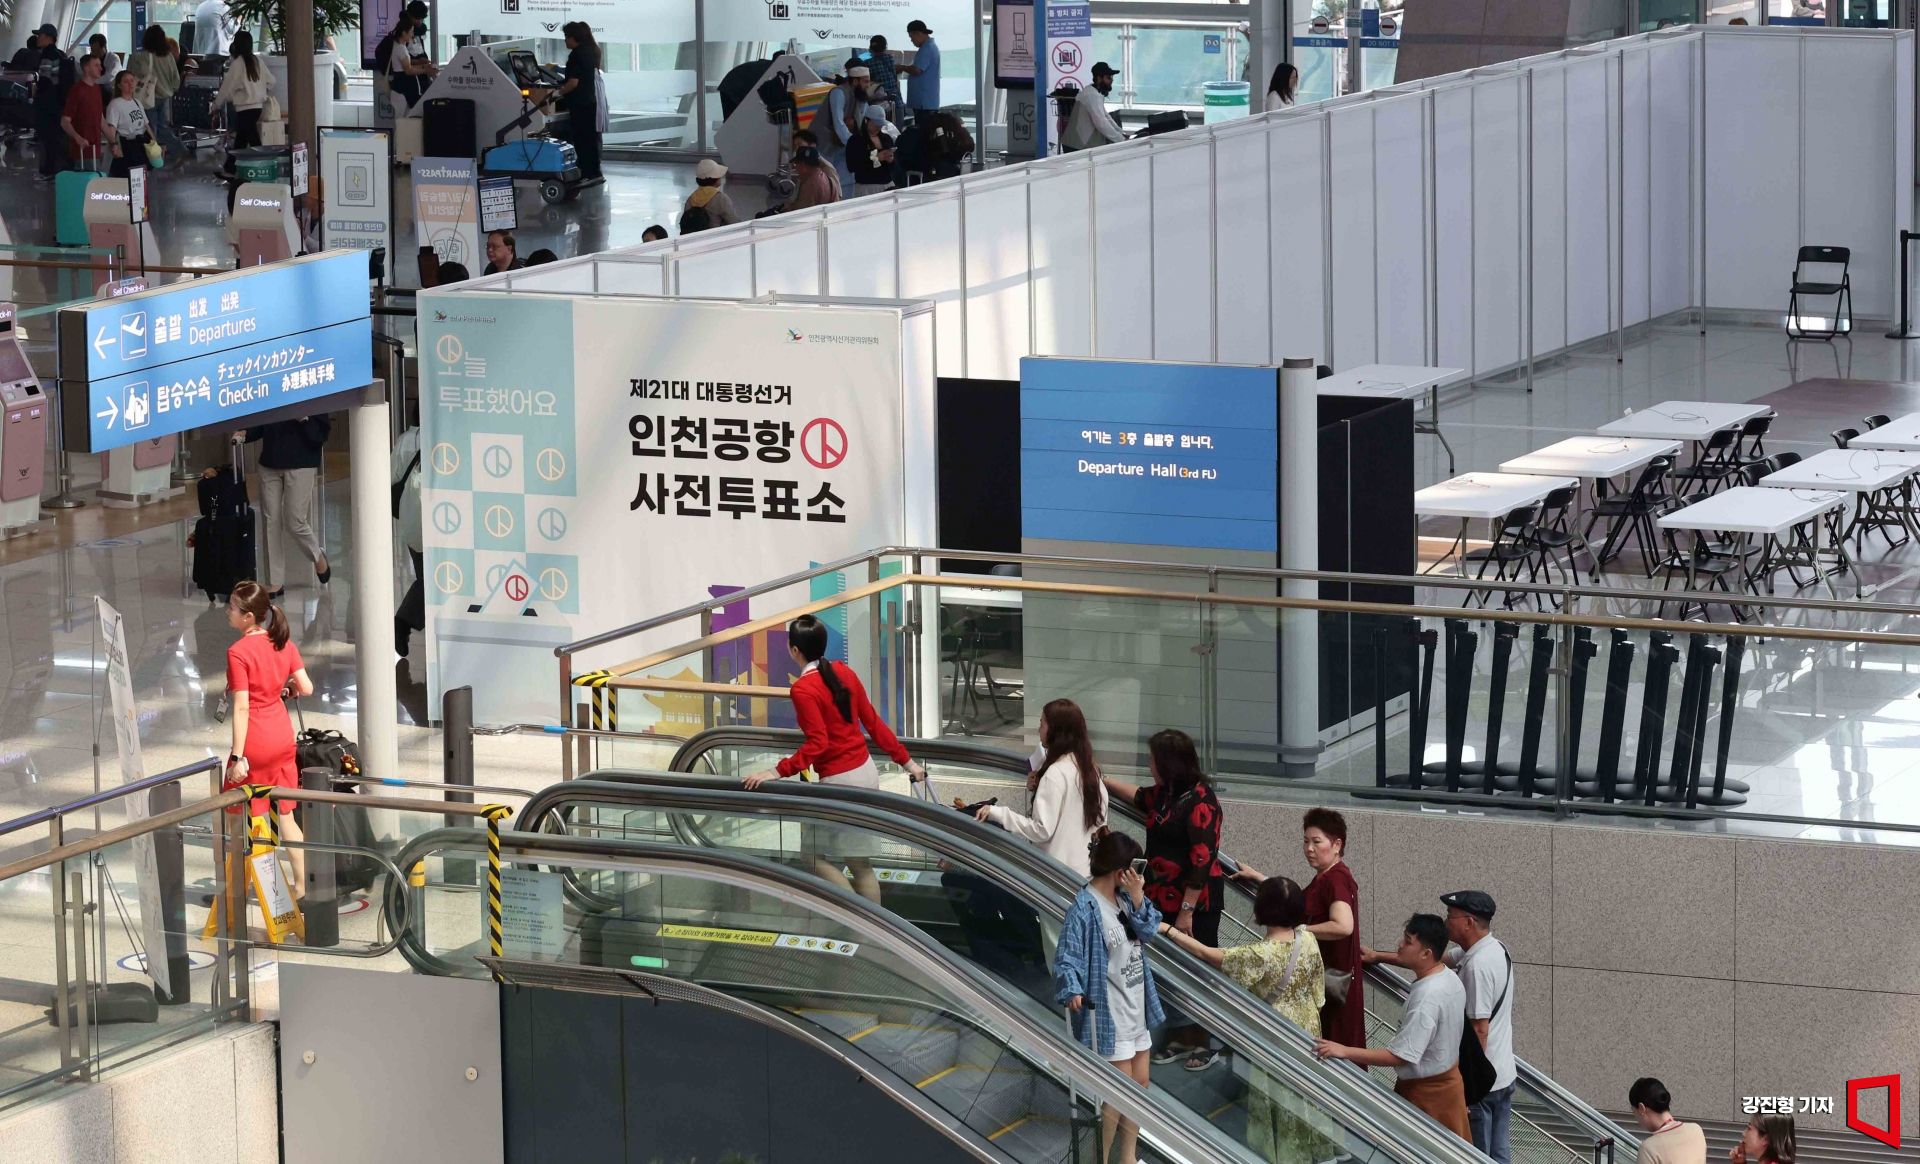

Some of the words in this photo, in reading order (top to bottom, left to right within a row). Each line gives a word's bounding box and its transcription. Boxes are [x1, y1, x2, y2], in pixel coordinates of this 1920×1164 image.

[90, 192, 103, 200] Self
[103, 193, 130, 201] Check-in
[240, 198, 253, 206] Self
[253, 199, 281, 207] Check-in
[113, 287, 123, 297] Self
[123, 284, 145, 294] Check-in
[221, 290, 240, 311] 出発
[189, 298, 208, 318] 出发
[154, 316, 182, 345] 출발
[189, 316, 257, 346] Departures
[217, 344, 315, 381] チェックインカウンター
[436, 334, 487, 378] 오늘
[281, 364, 335, 393] 办理乘机手续
[629, 378, 690, 400] 제21대
[696, 381, 792, 406] 대통령선거
[156, 376, 211, 414] 탑승수속
[218, 380, 269, 408] Check-in
[438, 385, 558, 416] 투표했어요
[628, 414, 795, 464] 인천공항
[1081, 430, 1112, 445] 여기는
[1119, 432, 1137, 446] 3층
[1143, 432, 1175, 448] 출발층
[1180, 434, 1214, 449] 입니다.
[1078, 459, 1144, 477] Departure
[1151, 463, 1177, 477] Hall
[1179, 467, 1199, 479] (3rd
[1201, 469, 1217, 480] FL)
[630, 472, 846, 523] 사전투표소
